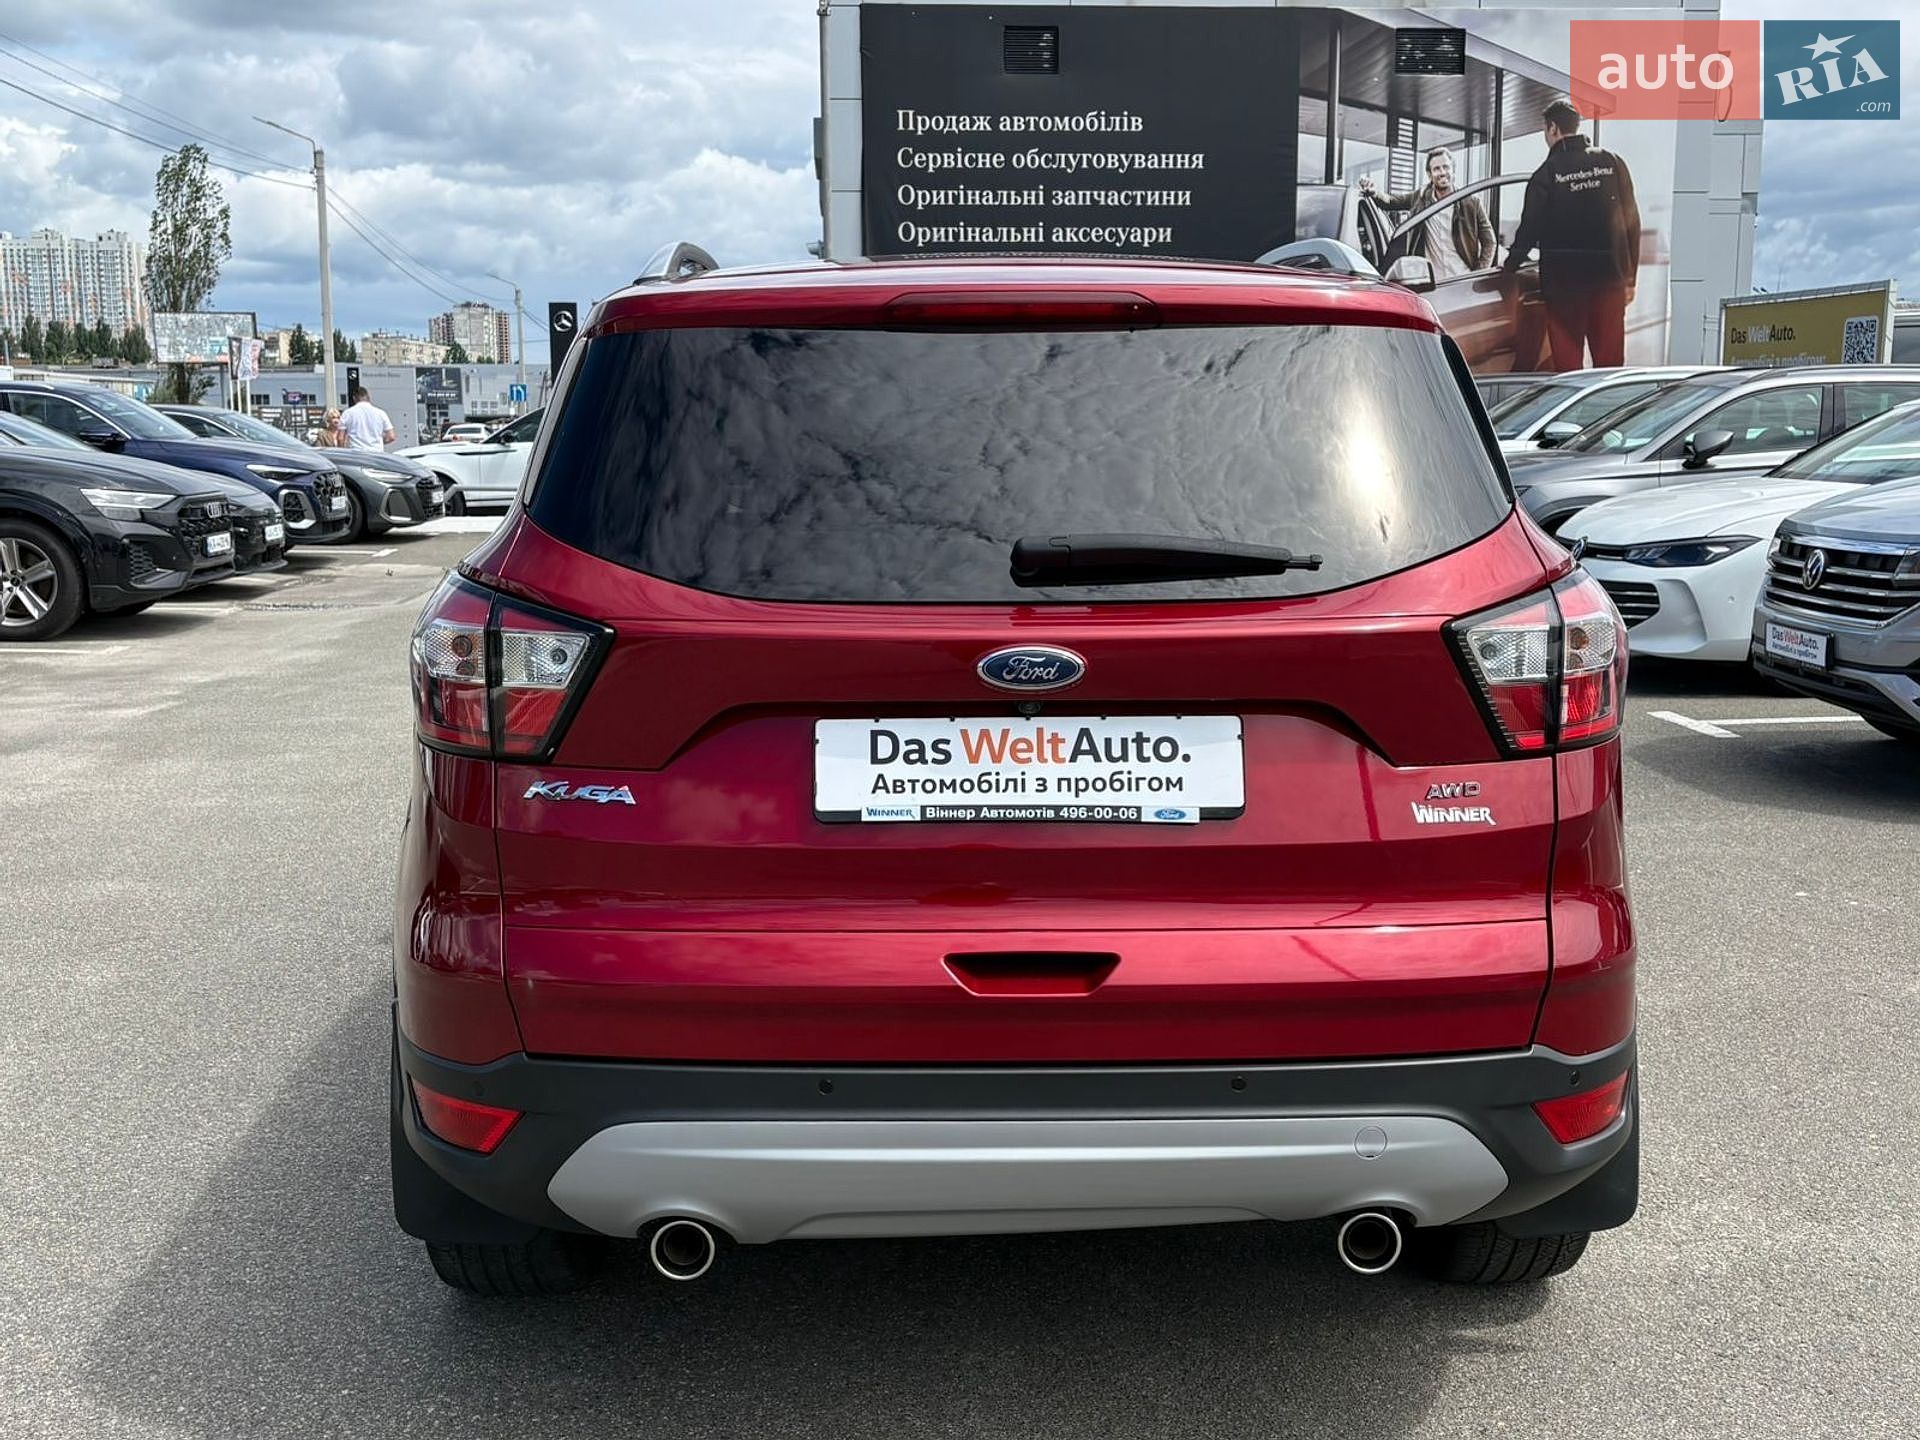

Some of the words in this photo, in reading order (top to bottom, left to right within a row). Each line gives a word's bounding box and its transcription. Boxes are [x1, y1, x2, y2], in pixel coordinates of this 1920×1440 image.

[896, 109, 993, 135] Продаж
[998, 110, 1144, 132] автомобілів
[896, 147, 1006, 173] Сервісне
[1012, 147, 1205, 174] обслуговування
[897, 184, 1046, 210] Оригінальні
[1051, 188, 1192, 206] запчастини
[1570, 179, 1601, 192] Service
[897, 221, 1046, 247] Оригінальні
[1051, 225, 1173, 248] аксесуари
[1731, 328, 1747, 344] Das
[1003, 656, 1060, 680] Ford
[870, 729, 952, 766] Das
[960, 727, 1192, 764] WeltAuto.
[523, 781, 637, 805] KUGA
[871, 771, 1027, 794] Автомобілі
[1035, 776, 1048, 793] з
[1057, 770, 1184, 798] пробігом
[1426, 781, 1481, 800] AWD
[866, 807, 915, 819] WINNER
[926, 807, 976, 820] Віннер
[980, 806, 1055, 819] Автомотів
[1059, 806, 1138, 819] 496-00-06
[1411, 801, 1497, 826] WINNER
